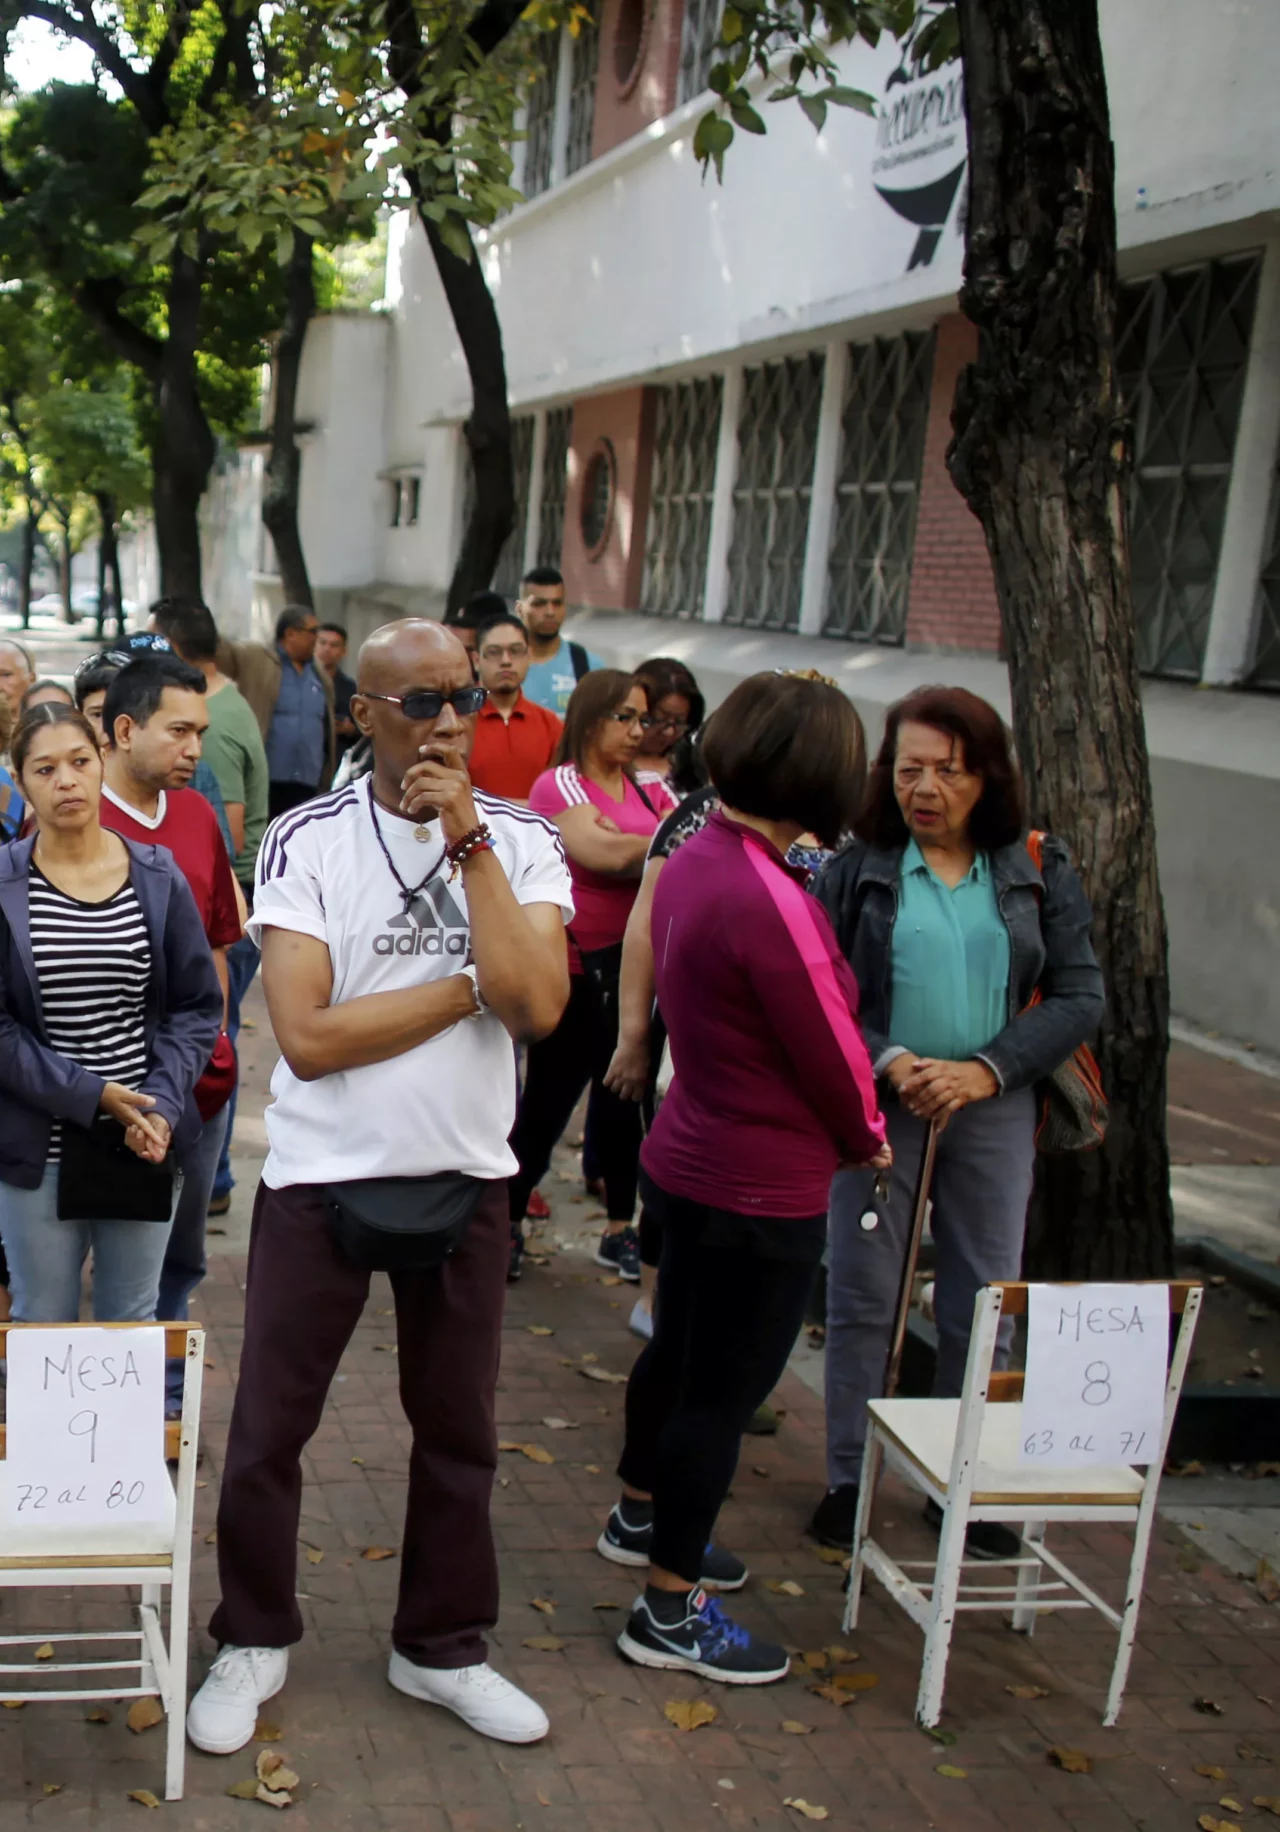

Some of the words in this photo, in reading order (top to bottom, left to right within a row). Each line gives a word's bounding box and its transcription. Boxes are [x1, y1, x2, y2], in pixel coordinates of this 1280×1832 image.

[372, 927, 472, 956] adida
[1057, 1300, 1145, 1342] MESA
[42, 1343, 141, 1398] MESA
[1081, 1360, 1112, 1407] 8
[67, 1409, 98, 1463] 9
[1023, 1430, 1054, 1455] 63
[1120, 1431, 1147, 1455] 71
[16, 1484, 49, 1512] 72
[106, 1480, 146, 1509] 80
